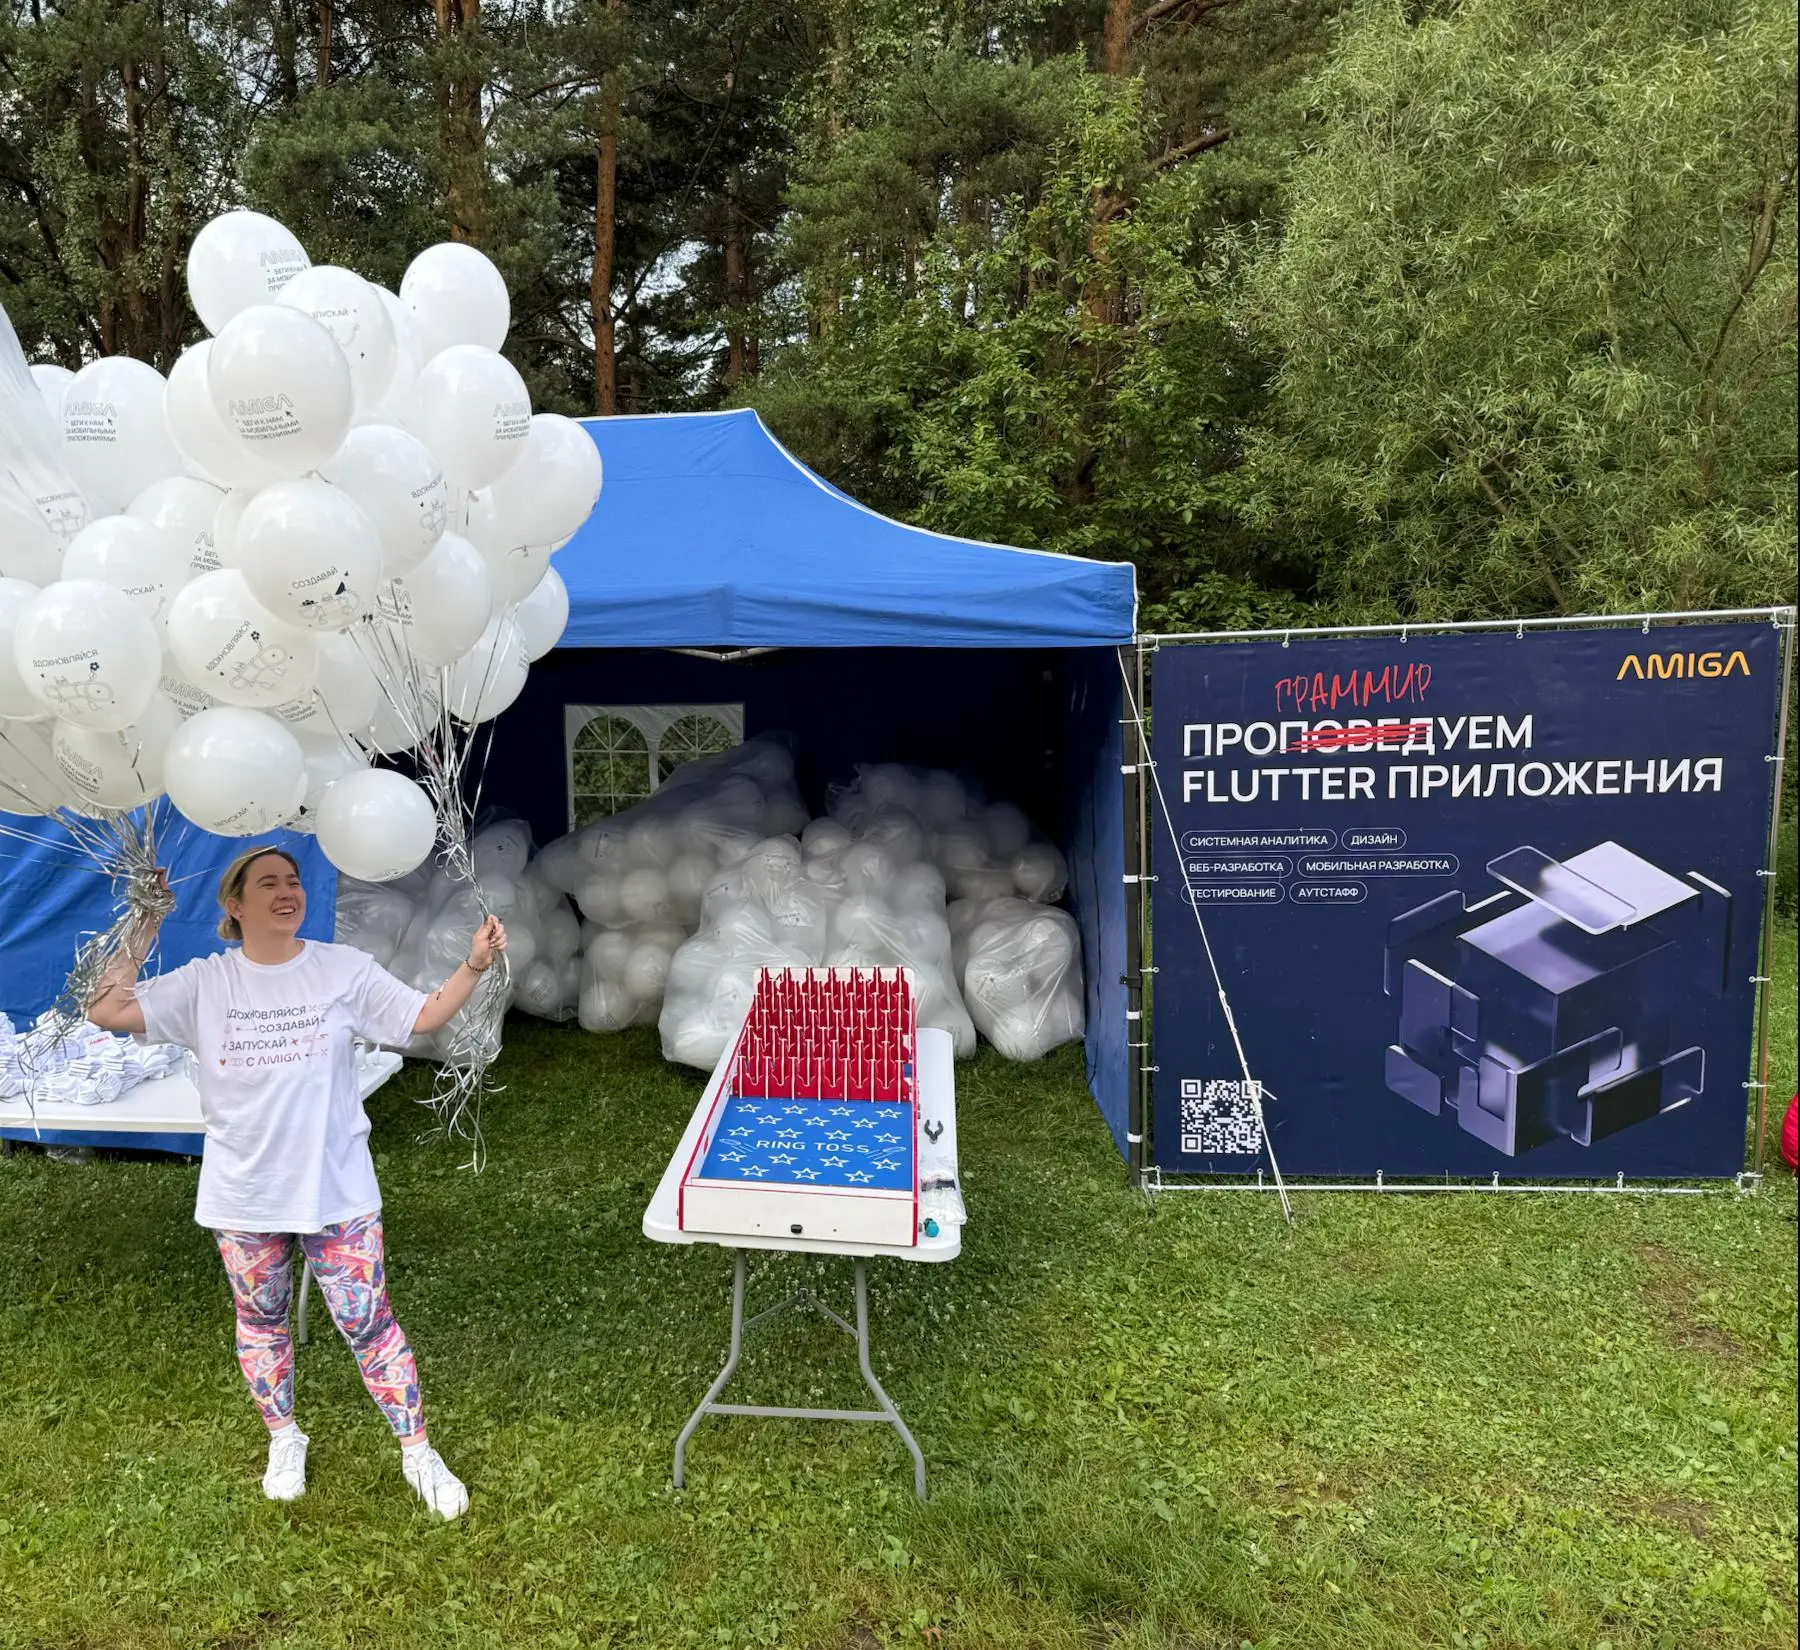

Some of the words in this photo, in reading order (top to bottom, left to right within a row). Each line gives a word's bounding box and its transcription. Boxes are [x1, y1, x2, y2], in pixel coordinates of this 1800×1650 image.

[291, 565, 338, 589] СОЗДАВАЙ
[1616, 651, 1751, 681] AMIGA
[1274, 662, 1432, 713] ГРАММИР
[1183, 714, 1533, 757] ПРОПОВЕДУЕМ
[1183, 766, 1376, 803] FLUTTER
[1388, 757, 1723, 799] ПРИЛОЖЕНИЯ
[1189, 836, 1258, 847] СИСТЕМНАЯ
[1260, 835, 1329, 846] АНАЛИТИКА
[1350, 833, 1398, 846] ДИЗАЙН
[1189, 862, 1284, 873] ВЕБ-РАЗРАБОТКА
[1306, 861, 1376, 872] МОБИЛЬНАЯ
[1378, 860, 1450, 871] РАЗРАБОТКА
[1190, 888, 1277, 899] ТЕСТИРОВАНИЕ
[1298, 887, 1359, 898] АУТСТАФФ
[259, 1016, 320, 1034] СОЗДАВАЙ
[229, 1036, 287, 1051] ЗАПУСКАЙ
[257, 1052, 302, 1066] AMIGA
[756, 1139, 806, 1151] RING
[814, 1141, 870, 1153] TOSS
